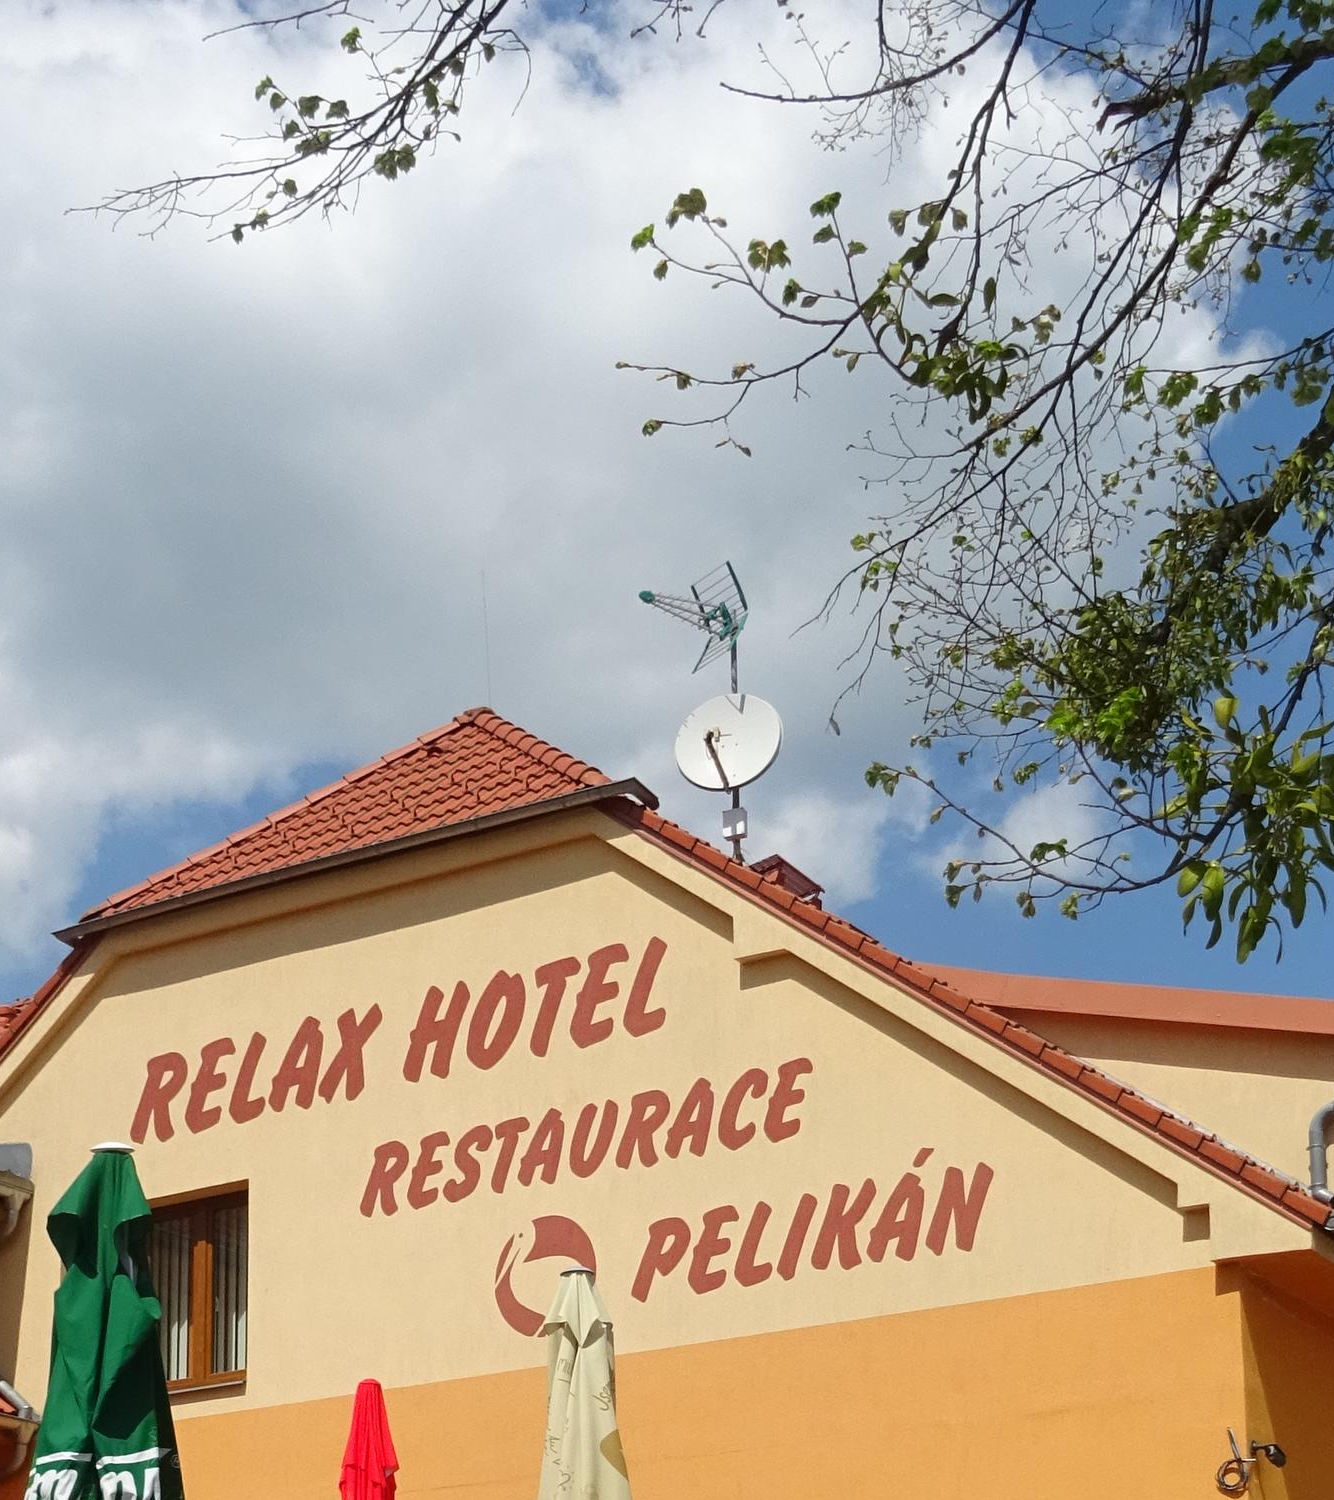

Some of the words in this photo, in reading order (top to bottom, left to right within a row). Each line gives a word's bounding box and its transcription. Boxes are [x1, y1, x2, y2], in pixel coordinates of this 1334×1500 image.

[130, 1002, 383, 1143] RELAX
[403, 937, 668, 1083] HOTEL
[359, 1057, 814, 1216] RESTAURACE
[631, 1147, 995, 1302] PELIKÁN
